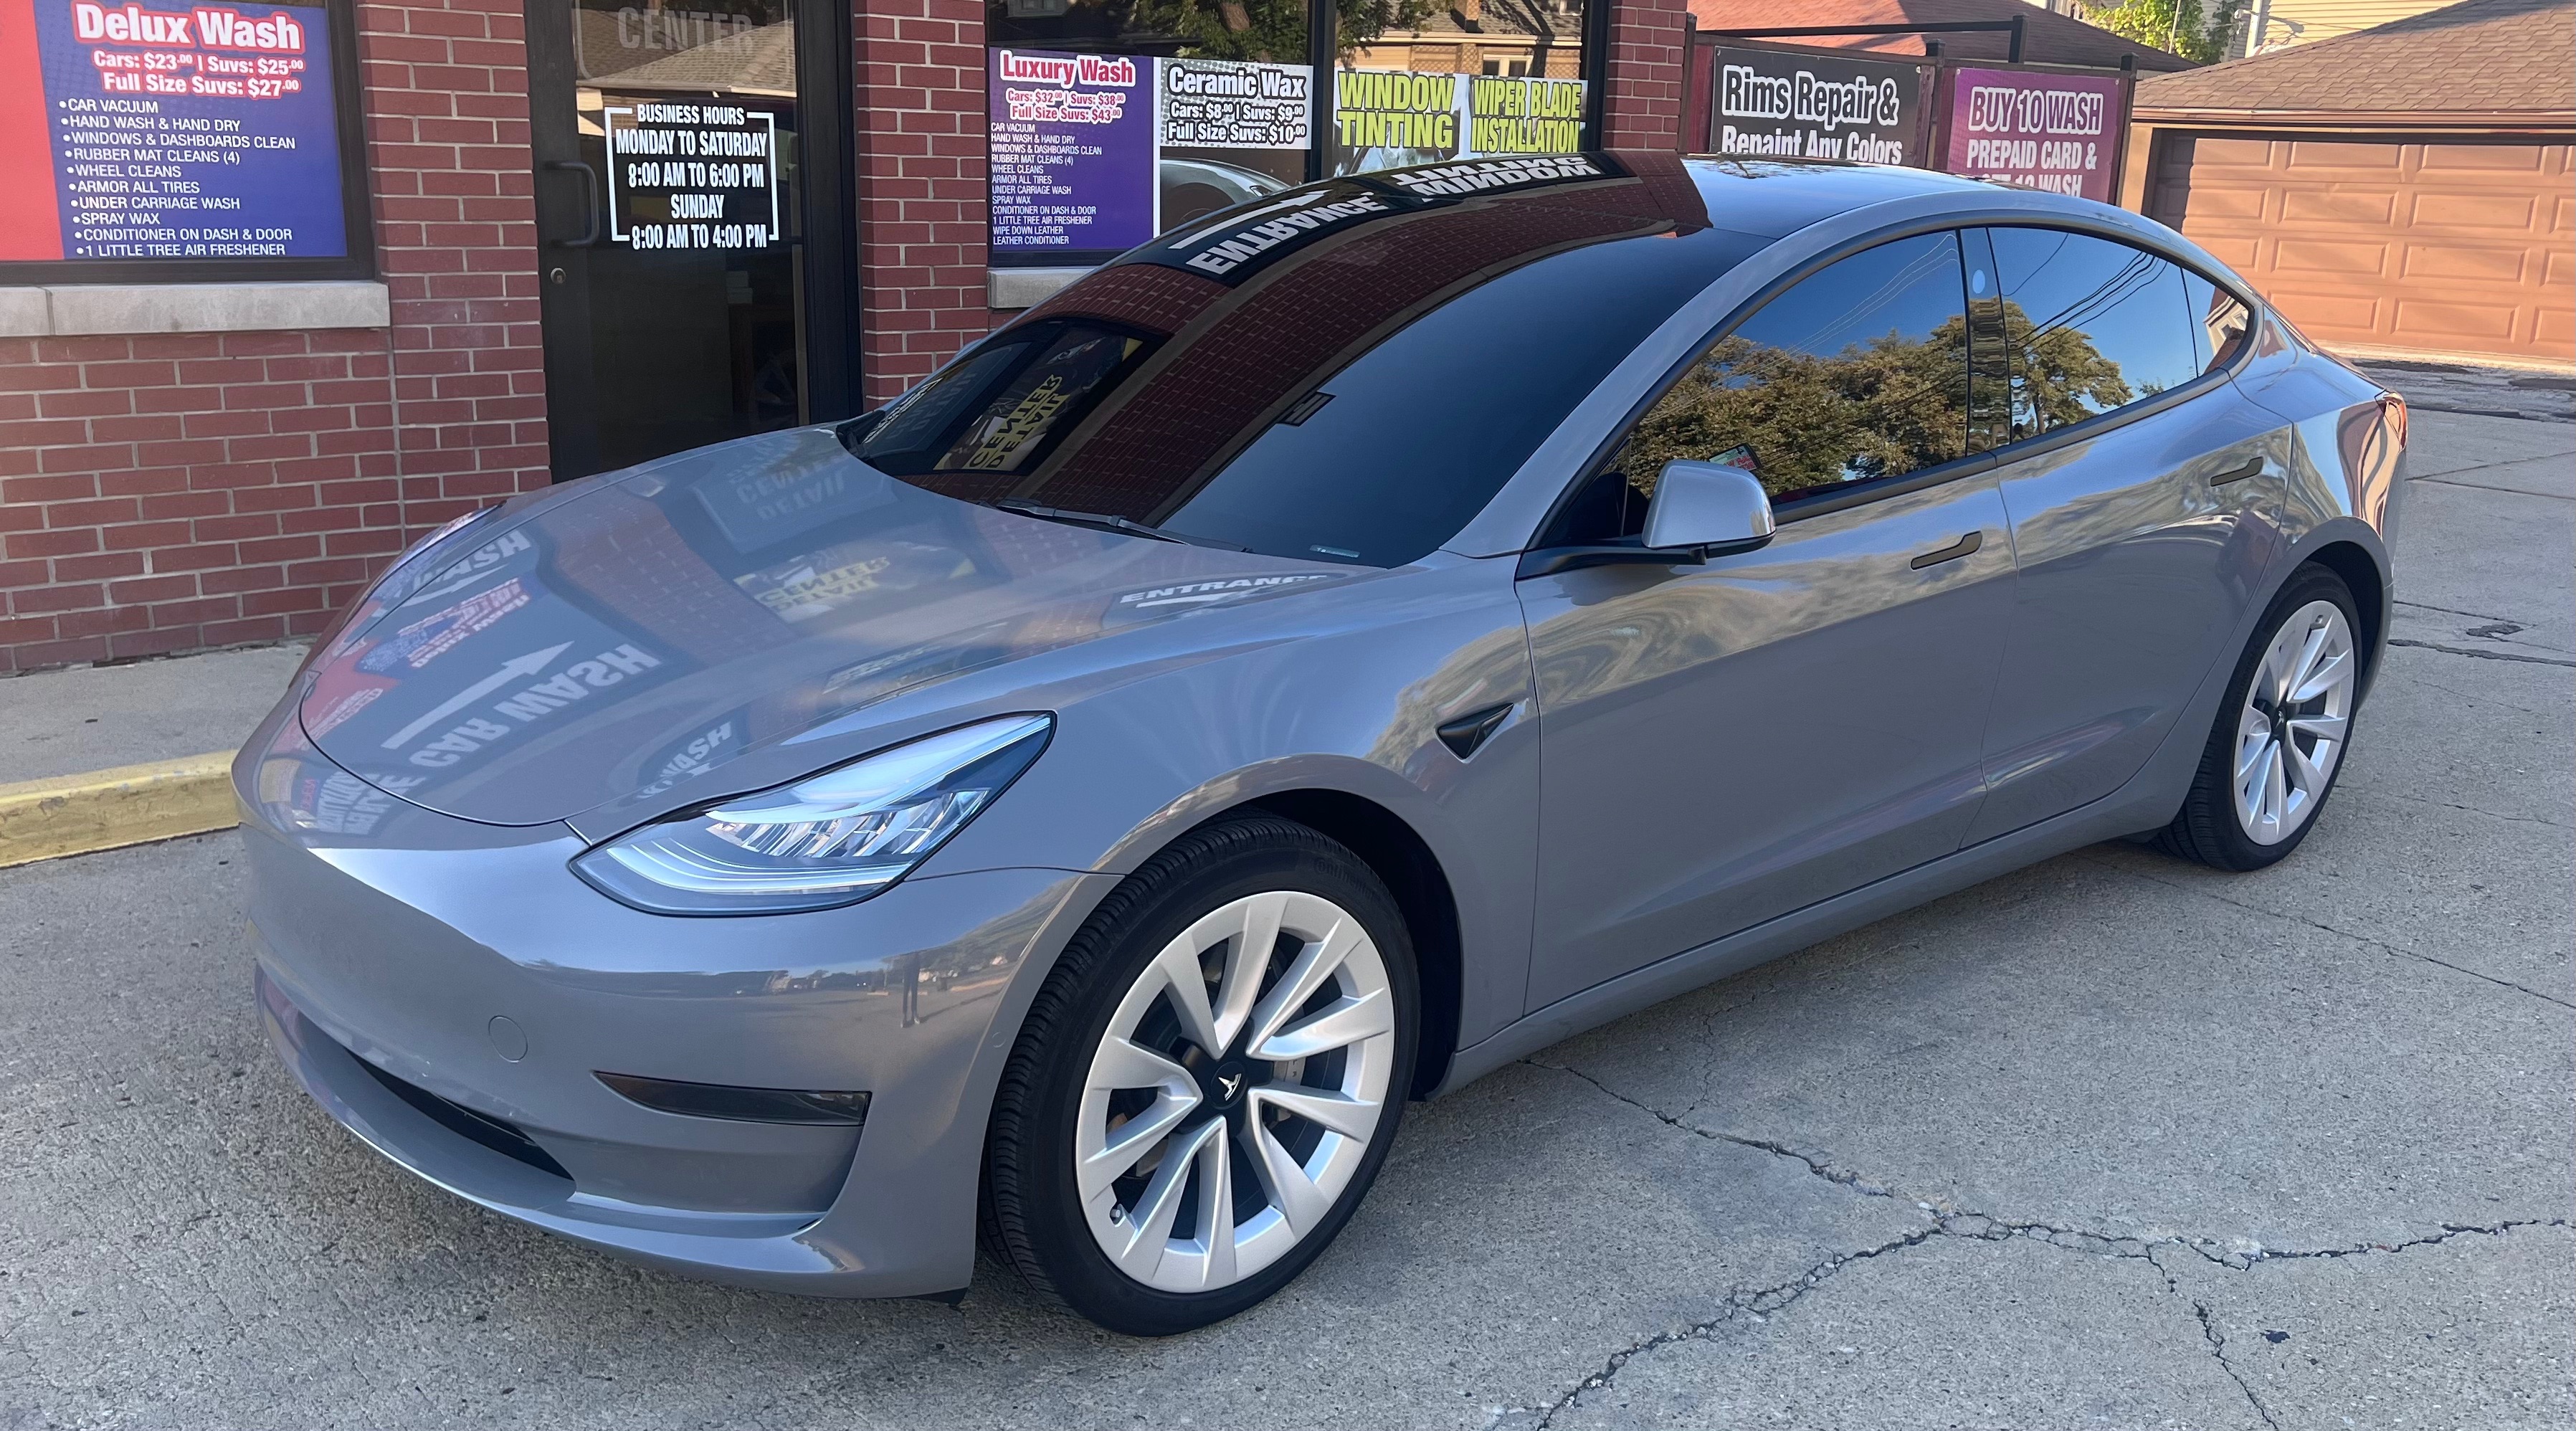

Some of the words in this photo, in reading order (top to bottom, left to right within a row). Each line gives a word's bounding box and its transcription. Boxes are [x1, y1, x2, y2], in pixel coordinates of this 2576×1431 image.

[76, 4, 191, 43] Delux
[196, 11, 300, 49] Wash
[617, 6, 753, 53] CENTER
[94, 50, 140, 68] Cars:
[144, 52, 192, 70] $23.00
[208, 56, 253, 73] Suvs:
[257, 57, 303, 75] $25.00
[1004, 54, 1074, 85] Luxury
[1080, 59, 1133, 82] Wash
[103, 72, 141, 90] Full
[146, 74, 186, 92] Size
[192, 76, 243, 95] Suvs:
[247, 77, 299, 98] $27.00
[1169, 67, 1257, 94] Ceramic
[1261, 72, 1304, 98] Wax
[1008, 90, 1032, 102] Cars:
[1071, 93, 1095, 105] Suvs:
[1338, 72, 1455, 111] WINDOW
[1473, 79, 1526, 115] WIPER
[1531, 81, 1582, 118] BLADE
[1725, 70, 1789, 115] Rims
[1797, 76, 1874, 125] Repair
[1880, 83, 1897, 120] &
[68, 98, 97, 111] CAR
[100, 100, 158, 113] VACUUM
[1012, 106, 1032, 118] Full
[1035, 107, 1057, 119] Size
[1060, 109, 1089, 120] Suvs:
[1171, 103, 1203, 118] Cars:
[1206, 103, 1233, 120] $8.00
[1243, 105, 1275, 120] Suvs:
[1278, 105, 1303, 122] $9.00
[1971, 91, 2012, 127] BUY
[2019, 94, 2041, 128] 10
[2048, 95, 2101, 130] WASH
[70, 115, 110, 128] HAND
[113, 117, 154, 129] WASH
[158, 118, 168, 129] &
[173, 118, 210, 130] HAND
[214, 119, 240, 131] DRY
[637, 104, 699, 123] BUSINESS
[703, 106, 744, 125] HOURS
[991, 123, 1004, 131] CAR
[1007, 123, 1035, 133] VACUUM
[1168, 123, 1194, 139] Full
[1198, 123, 1227, 141] Size
[1230, 125, 1266, 141] Suvs:
[1269, 125, 1306, 143] $10.00
[1337, 110, 1453, 149] TINTING
[1471, 118, 1579, 153] INSTALLATION
[72, 131, 141, 145] WINDOWS
[146, 133, 156, 146] &
[160, 134, 250, 148] DASHBOARDS
[255, 136, 295, 149] CLEAN
[615, 129, 675, 154] MONDAY
[678, 130, 695, 155] TO
[700, 131, 767, 156] SATURDAY
[991, 133, 1010, 142] HAND
[1012, 134, 1032, 143] WASH
[1035, 134, 1040, 143] &
[1041, 135, 1060, 143] HAND
[1062, 136, 1075, 144] DRY
[1722, 125, 1802, 156] Repaint
[1805, 130, 1843, 159] Any
[1847, 132, 1903, 165] Colors
[74, 148, 130, 161] RUBBER
[134, 149, 163, 161] MAT
[168, 150, 219, 163] CLEANS
[224, 151, 240, 165] (4)
[991, 143, 1025, 153] WINDOWS
[1035, 145, 1079, 154] DASHBOARDS
[1081, 146, 1102, 155] CLEAN
[1967, 139, 2037, 168] PREPAID
[2041, 141, 2082, 170] CARD
[2085, 143, 2097, 170] &
[992, 154, 1019, 163] RUBBER
[1037, 155, 1063, 163] CLEANS
[1065, 156, 1073, 166] (4)
[992, 164, 1016, 173] WHEEL
[1017, 165, 1043, 173] CLEANS
[75, 164, 124, 176] WHEEL
[128, 165, 181, 177] CLEANS
[628, 162, 660, 188] 8:00
[663, 162, 686, 186] AM
[688, 163, 705, 187] TO
[710, 163, 739, 187] 6:00
[743, 163, 764, 187] PM
[78, 181, 129, 193] ARMOR
[133, 181, 158, 193] ALL
[162, 181, 200, 194] TIRES
[992, 175, 1017, 184] ARMOR
[1019, 175, 1031, 184] ALL
[1033, 176, 1052, 184] TIRES
[992, 185, 1015, 194] UNDER
[1017, 186, 1050, 194] CARRIAGE
[1052, 186, 1072, 194] WASH
[80, 196, 128, 209] UNDER
[131, 196, 198, 209] CARRIAGE
[201, 198, 240, 209] WASH
[670, 194, 724, 219] SUNDAY
[992, 196, 1014, 204] SPRAY
[1016, 196, 1031, 204] WAX
[81, 213, 125, 224] SPRAY
[129, 213, 160, 224] WAX
[993, 206, 1038, 214] CONDITIONER
[1040, 206, 1050, 214] ON
[1052, 206, 1069, 214] DASH
[999, 216, 1021, 224] LITTLE
[1042, 216, 1052, 224] AIR
[1055, 216, 1093, 224] FRESHENER
[84, 229, 176, 241] CONDITIONER
[180, 229, 199, 240] ON
[204, 229, 238, 240] DASH
[243, 229, 252, 240] &
[256, 229, 293, 240] DOOR
[632, 224, 663, 249] 8:00
[667, 224, 688, 248] AM
[691, 224, 708, 248] TO
[713, 224, 742, 248] 4:00
[746, 224, 766, 248] PM
[993, 226, 1010, 234] WIPE
[1012, 226, 1032, 234] DOWN
[1035, 226, 1063, 234] LEATHER
[994, 236, 1022, 244] LEATHER
[1025, 236, 1069, 244] CONDITIONER
[86, 245, 92, 256] 1
[98, 244, 143, 257] LITTLE
[147, 244, 181, 256] TREE
[185, 244, 206, 255] AIR
[210, 244, 285, 255] FRESHENER
